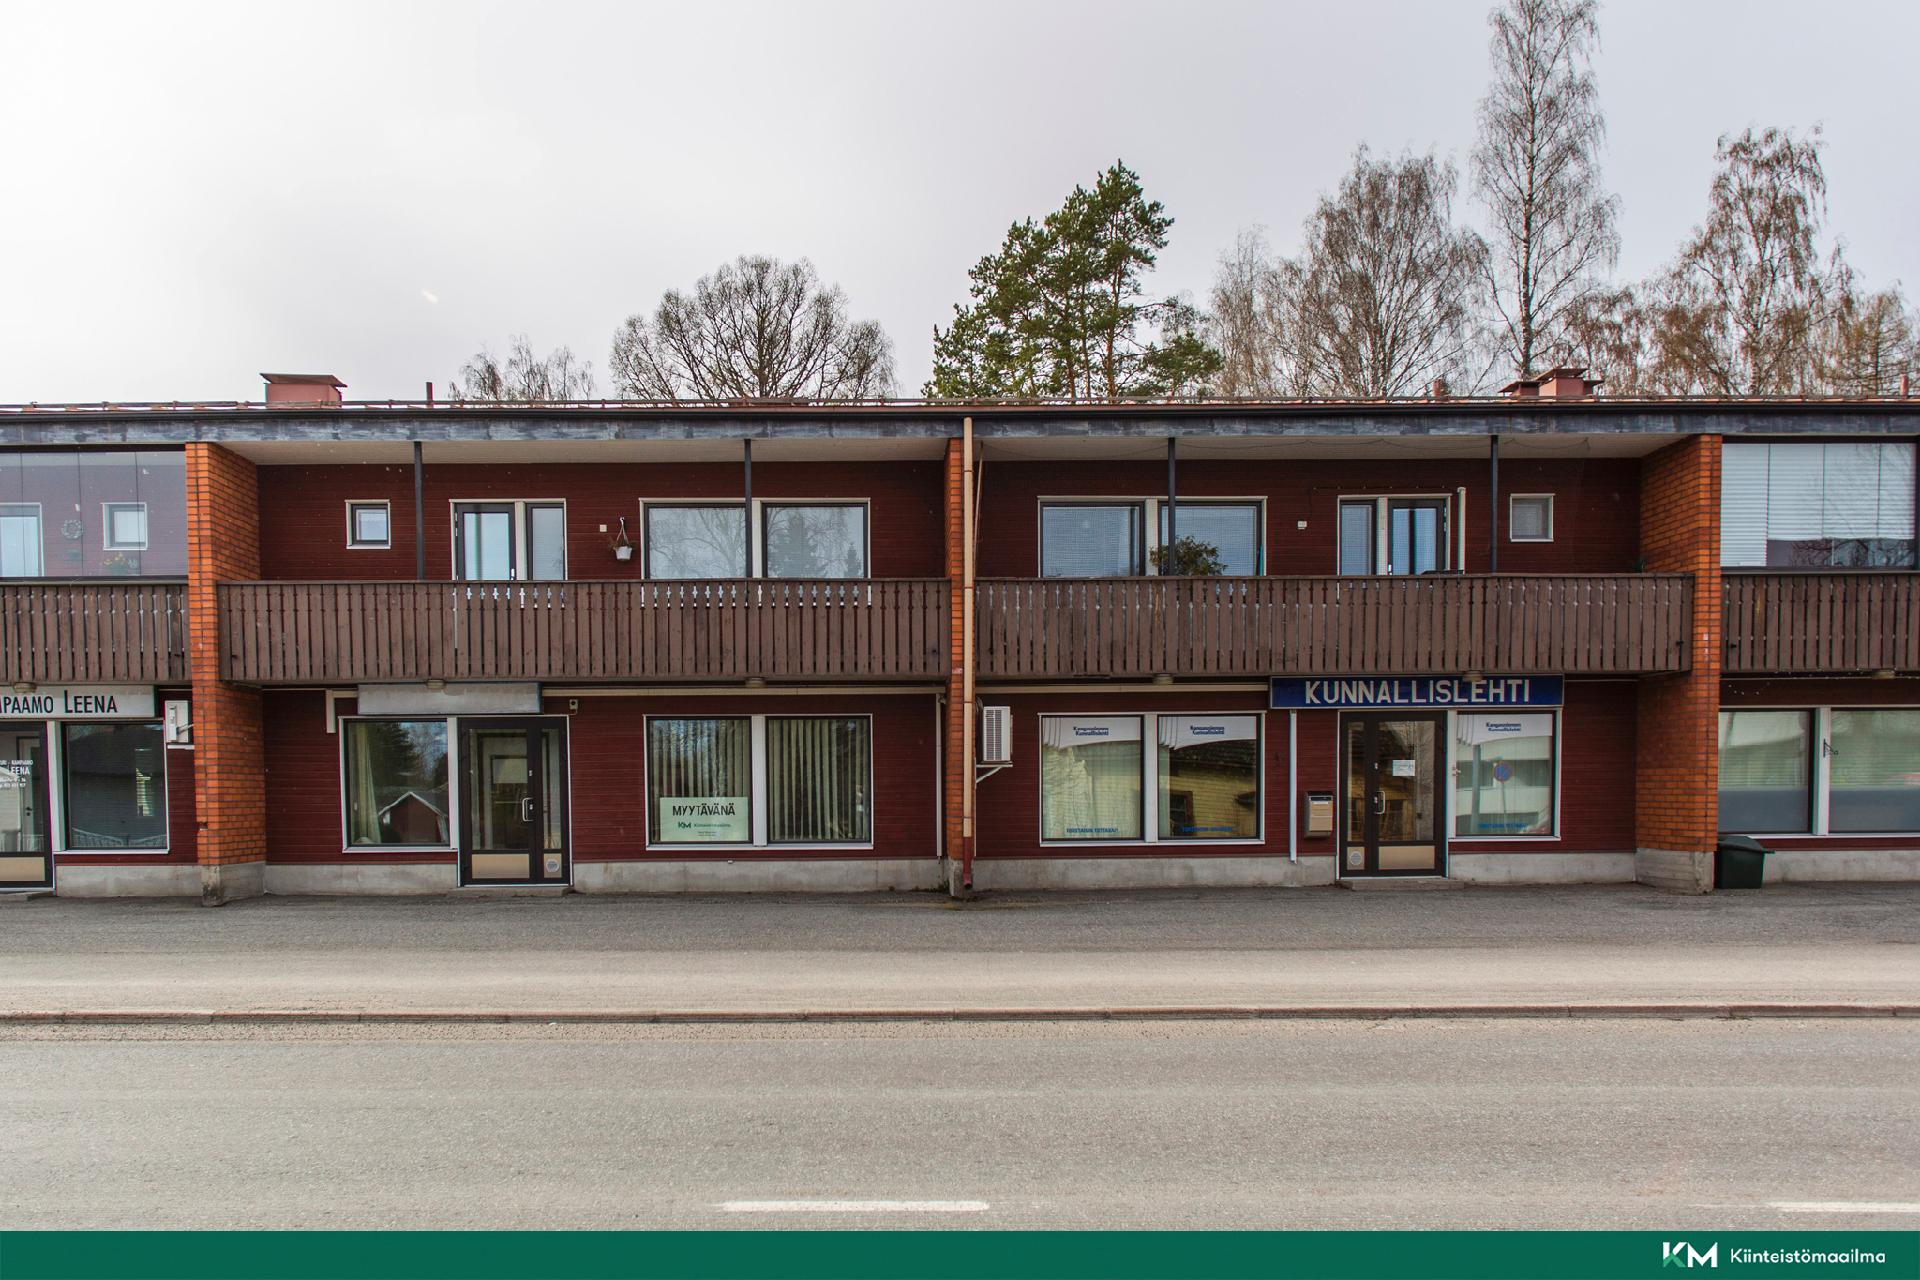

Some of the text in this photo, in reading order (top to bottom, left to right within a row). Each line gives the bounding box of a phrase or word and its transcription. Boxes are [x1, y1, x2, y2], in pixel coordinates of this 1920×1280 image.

[0, 690, 118, 714] PAAMO LEENA
[1304, 679, 1530, 704] KUNNALLISLEHTI
[672, 802, 736, 816] MYYTÄVÄNÄ
